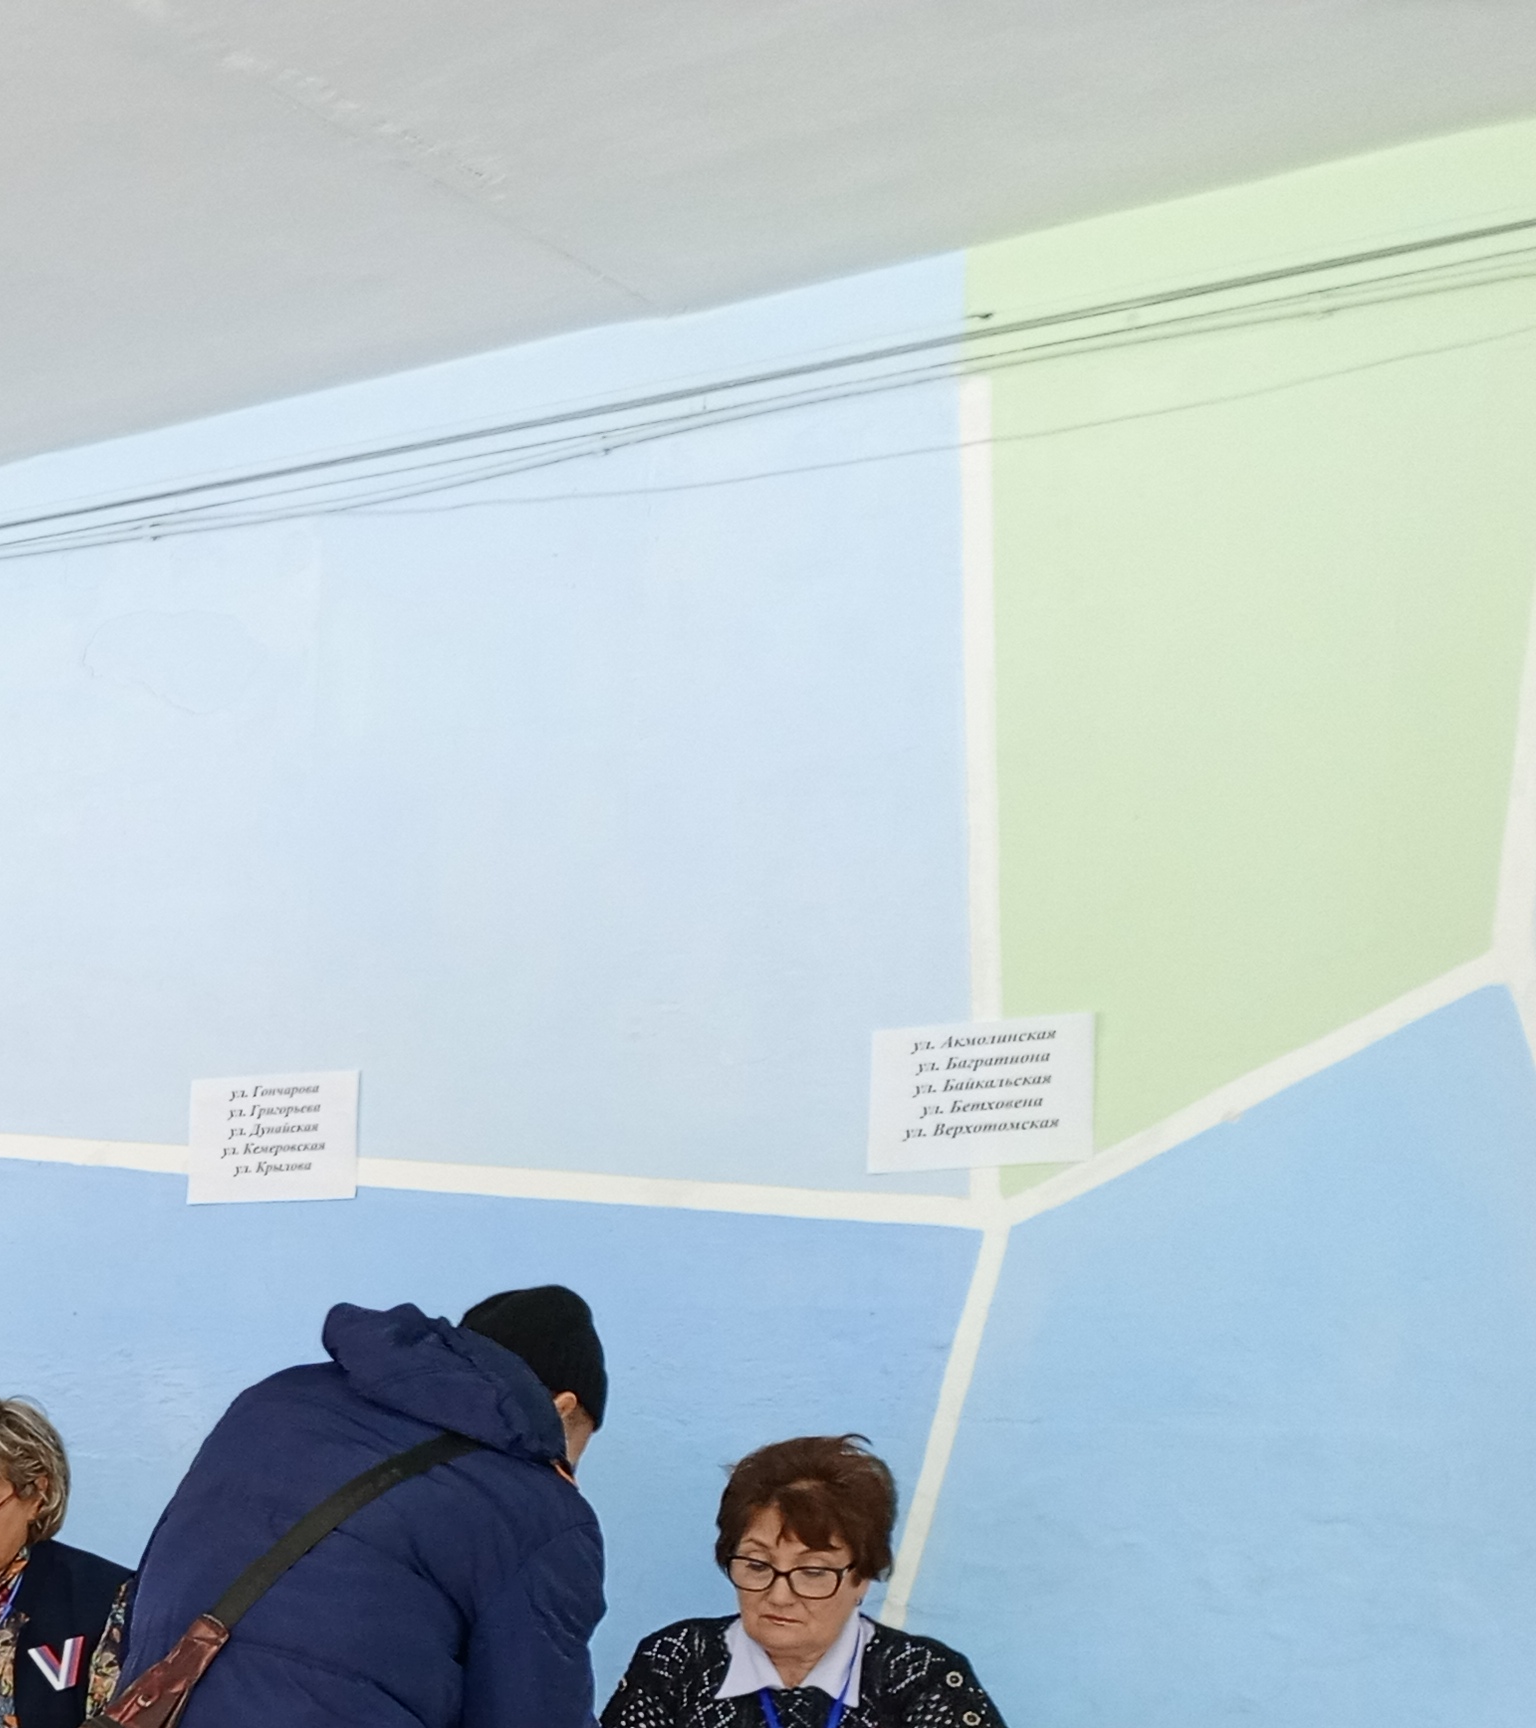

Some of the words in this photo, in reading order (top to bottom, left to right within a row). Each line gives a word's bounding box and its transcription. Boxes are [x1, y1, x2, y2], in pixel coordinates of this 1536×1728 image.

[911, 1039, 935, 1055] ул.
[940, 1028, 1057, 1049] Акмолинская
[915, 1060, 940, 1076] ул.
[946, 1051, 1050, 1071] Багратиона
[229, 1090, 249, 1102] ул.
[253, 1083, 320, 1099] Гончарова
[913, 1083, 937, 1098] ул.
[943, 1073, 1052, 1094] Байкальская
[228, 1108, 246, 1120] ул.
[250, 1103, 322, 1119] Григорьева
[920, 1104, 944, 1119] ул.
[950, 1096, 1044, 1114] Бетховена
[228, 1127, 246, 1139] ул.
[249, 1122, 319, 1138] Дунайская
[902, 1127, 927, 1142] ул.
[933, 1117, 1060, 1139] Верхотомская
[221, 1146, 239, 1159] ул.
[243, 1142, 326, 1157] Кемеровская
[233, 1165, 252, 1177] ул.
[255, 1160, 313, 1176] Крылова
